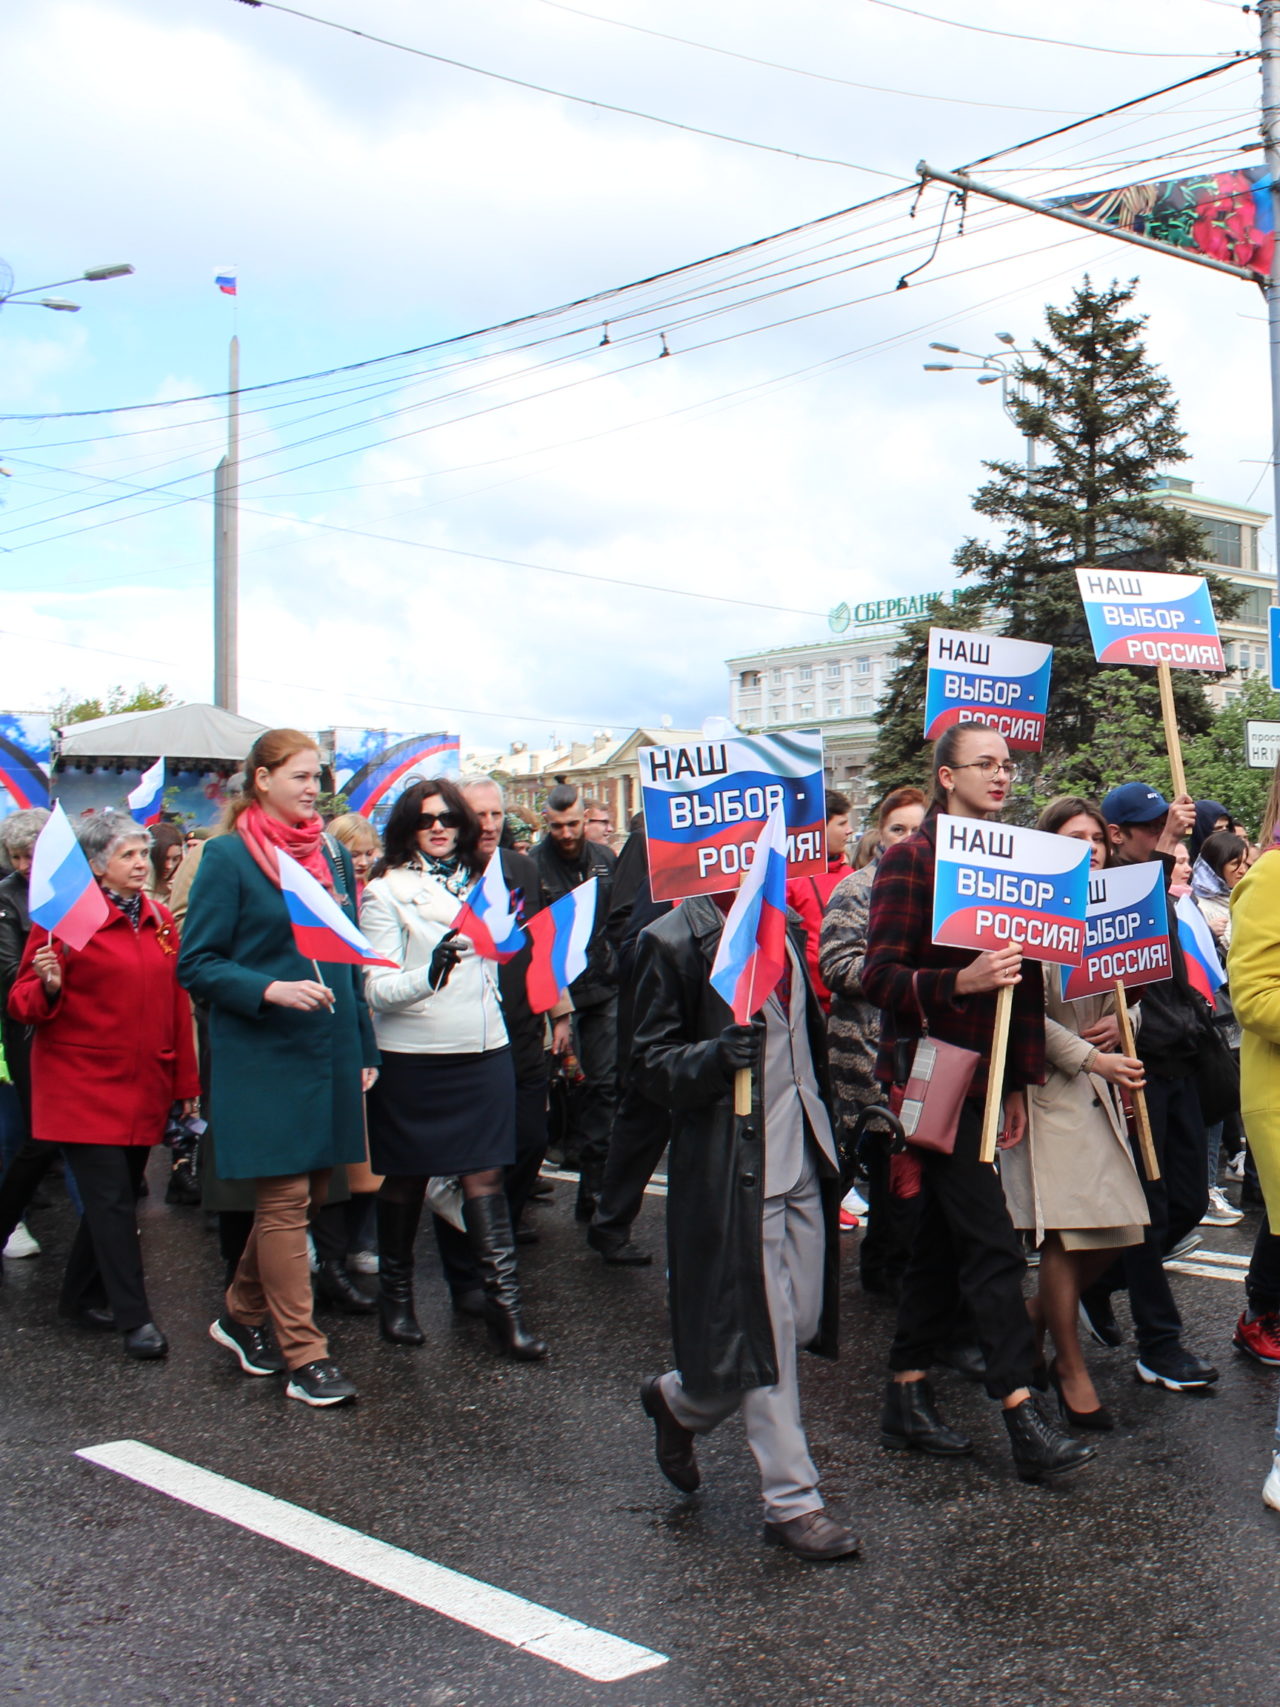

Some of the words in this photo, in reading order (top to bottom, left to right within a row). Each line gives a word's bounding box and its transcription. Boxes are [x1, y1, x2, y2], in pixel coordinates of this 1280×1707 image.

[1087, 576, 1142, 596] НАШ
[1102, 605, 1185, 629] ВЫБОР
[939, 637, 990, 665] НАШ
[1126, 639, 1220, 665] РОССИЯ!
[944, 674, 1021, 706] ВЫБОР
[649, 744, 729, 782] НАШ
[669, 784, 785, 829] ВЫБОР
[697, 831, 821, 878] РОСИЯ!
[950, 825, 1014, 859] НАШ
[957, 867, 1054, 908] ВЫБОР
[975, 909, 1080, 953] РОССИЯ!
[1084, 912, 1141, 947] ЫБОР
[1088, 943, 1168, 982] РОССИЯ!
